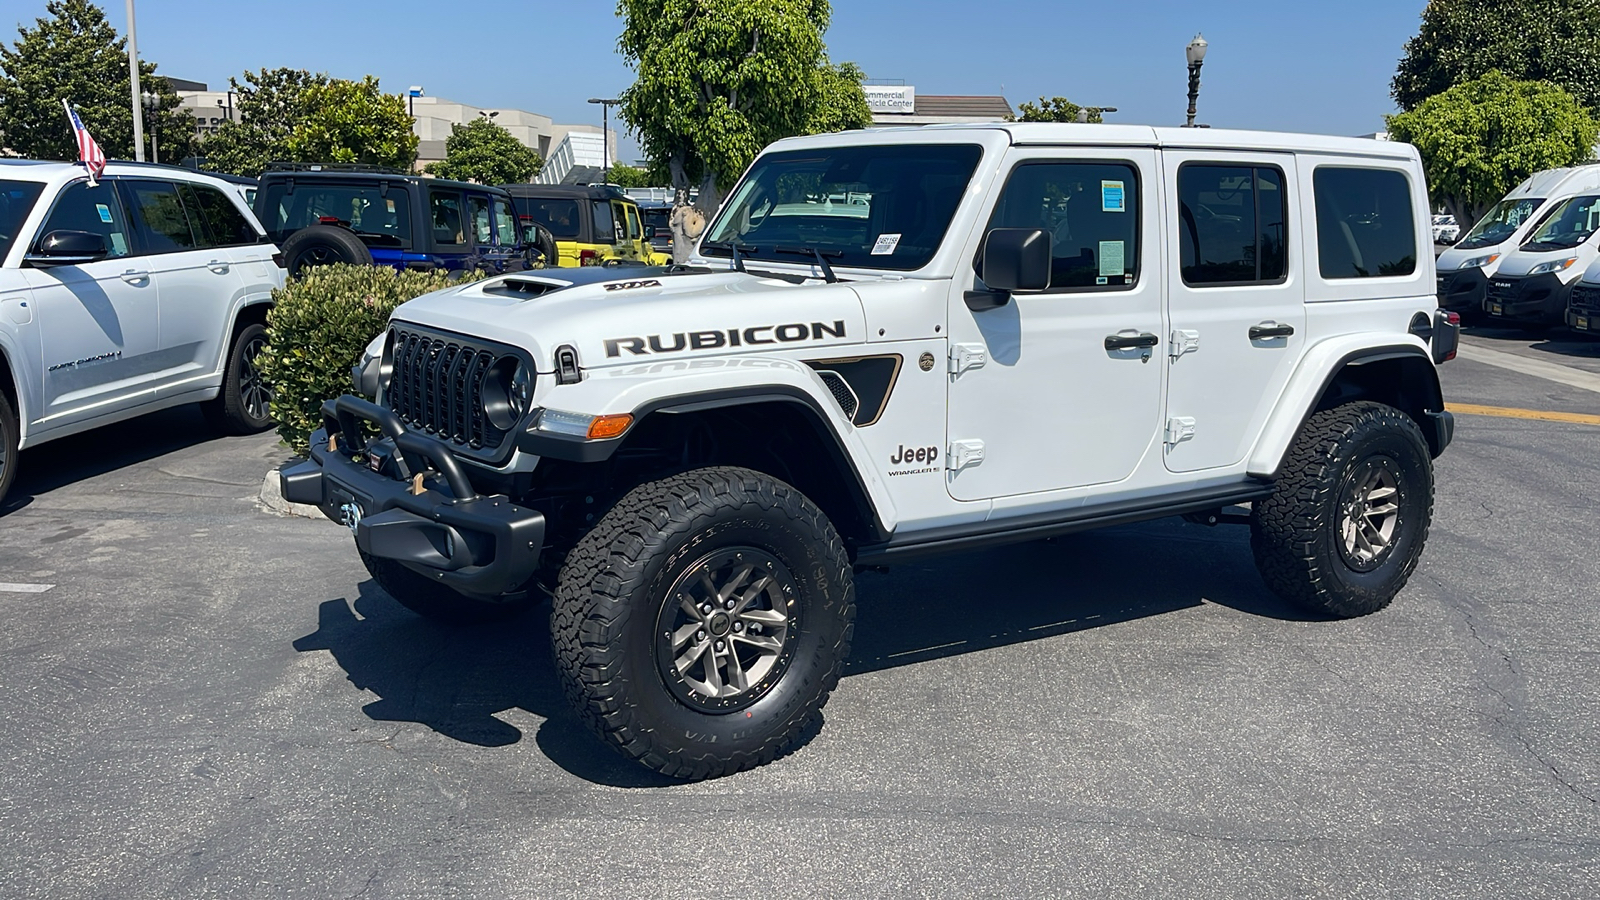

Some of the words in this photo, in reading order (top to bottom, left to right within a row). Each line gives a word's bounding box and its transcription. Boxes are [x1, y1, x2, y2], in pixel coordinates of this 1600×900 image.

[887, 99, 913, 107] Center
[603, 319, 847, 358] RUBICON
[890, 444, 938, 465] Jeep
[888, 467, 932, 477] WRANGLER
